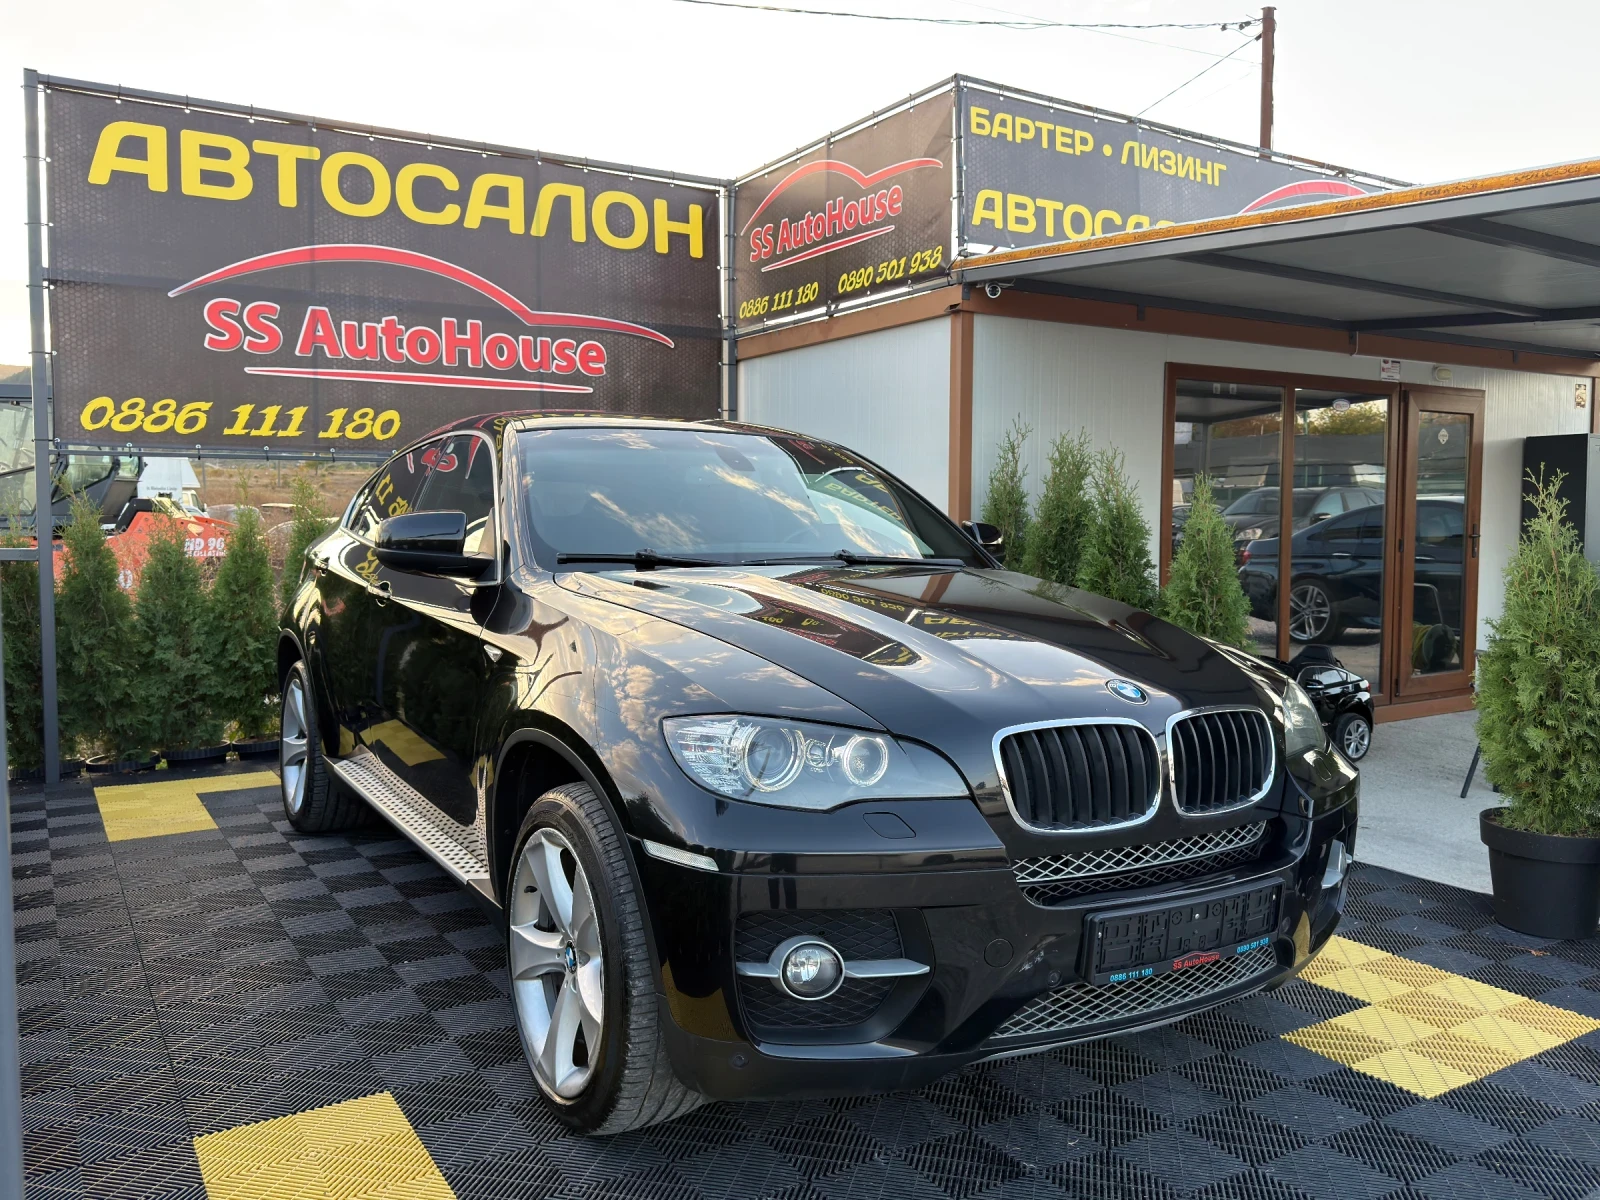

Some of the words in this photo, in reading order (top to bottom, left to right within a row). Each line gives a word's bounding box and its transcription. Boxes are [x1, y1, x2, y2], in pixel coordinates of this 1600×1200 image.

[970, 106, 1094, 156] БАРТЕР
[1121, 141, 1227, 186] ЛИЗИНГ
[88, 121, 703, 259] АВТОСАЛОН
[750, 223, 774, 262] SS
[777, 185, 903, 254] AutoHouse
[838, 265, 874, 295] 0890
[876, 256, 907, 284] 501
[909, 245, 943, 275] 938
[739, 295, 769, 320] 0886
[771, 289, 793, 312] 111
[795, 281, 819, 306] 180
[203, 297, 283, 354] SS
[295, 305, 607, 376] AutoHouse
[80, 396, 213, 435] 0886
[223, 403, 309, 438] 111
[318, 407, 401, 441] 180
[1128, 970, 1140, 979] 111
[1172, 961, 1183, 971] SS
[1183, 954, 1220, 968] AutoHouse
